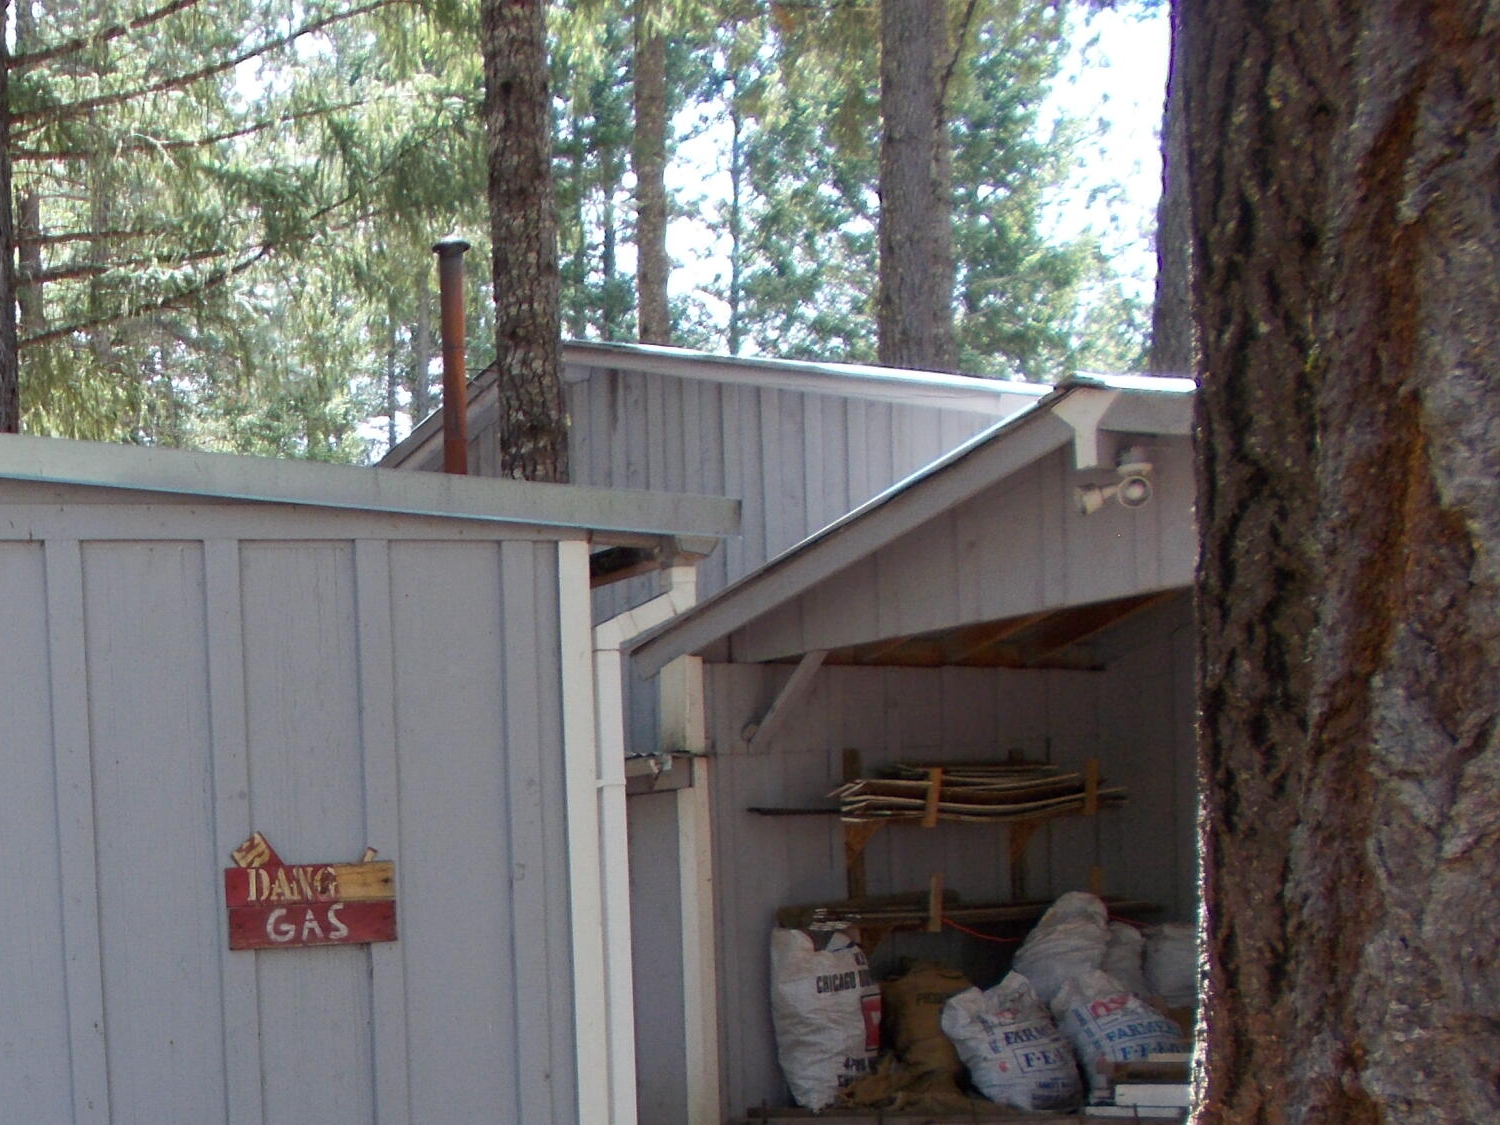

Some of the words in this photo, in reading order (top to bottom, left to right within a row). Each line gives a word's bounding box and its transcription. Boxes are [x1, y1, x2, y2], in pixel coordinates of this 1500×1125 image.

[246, 866, 339, 902] DANG
[265, 902, 349, 943] GAS
[816, 970, 856, 994] CHICAGO
